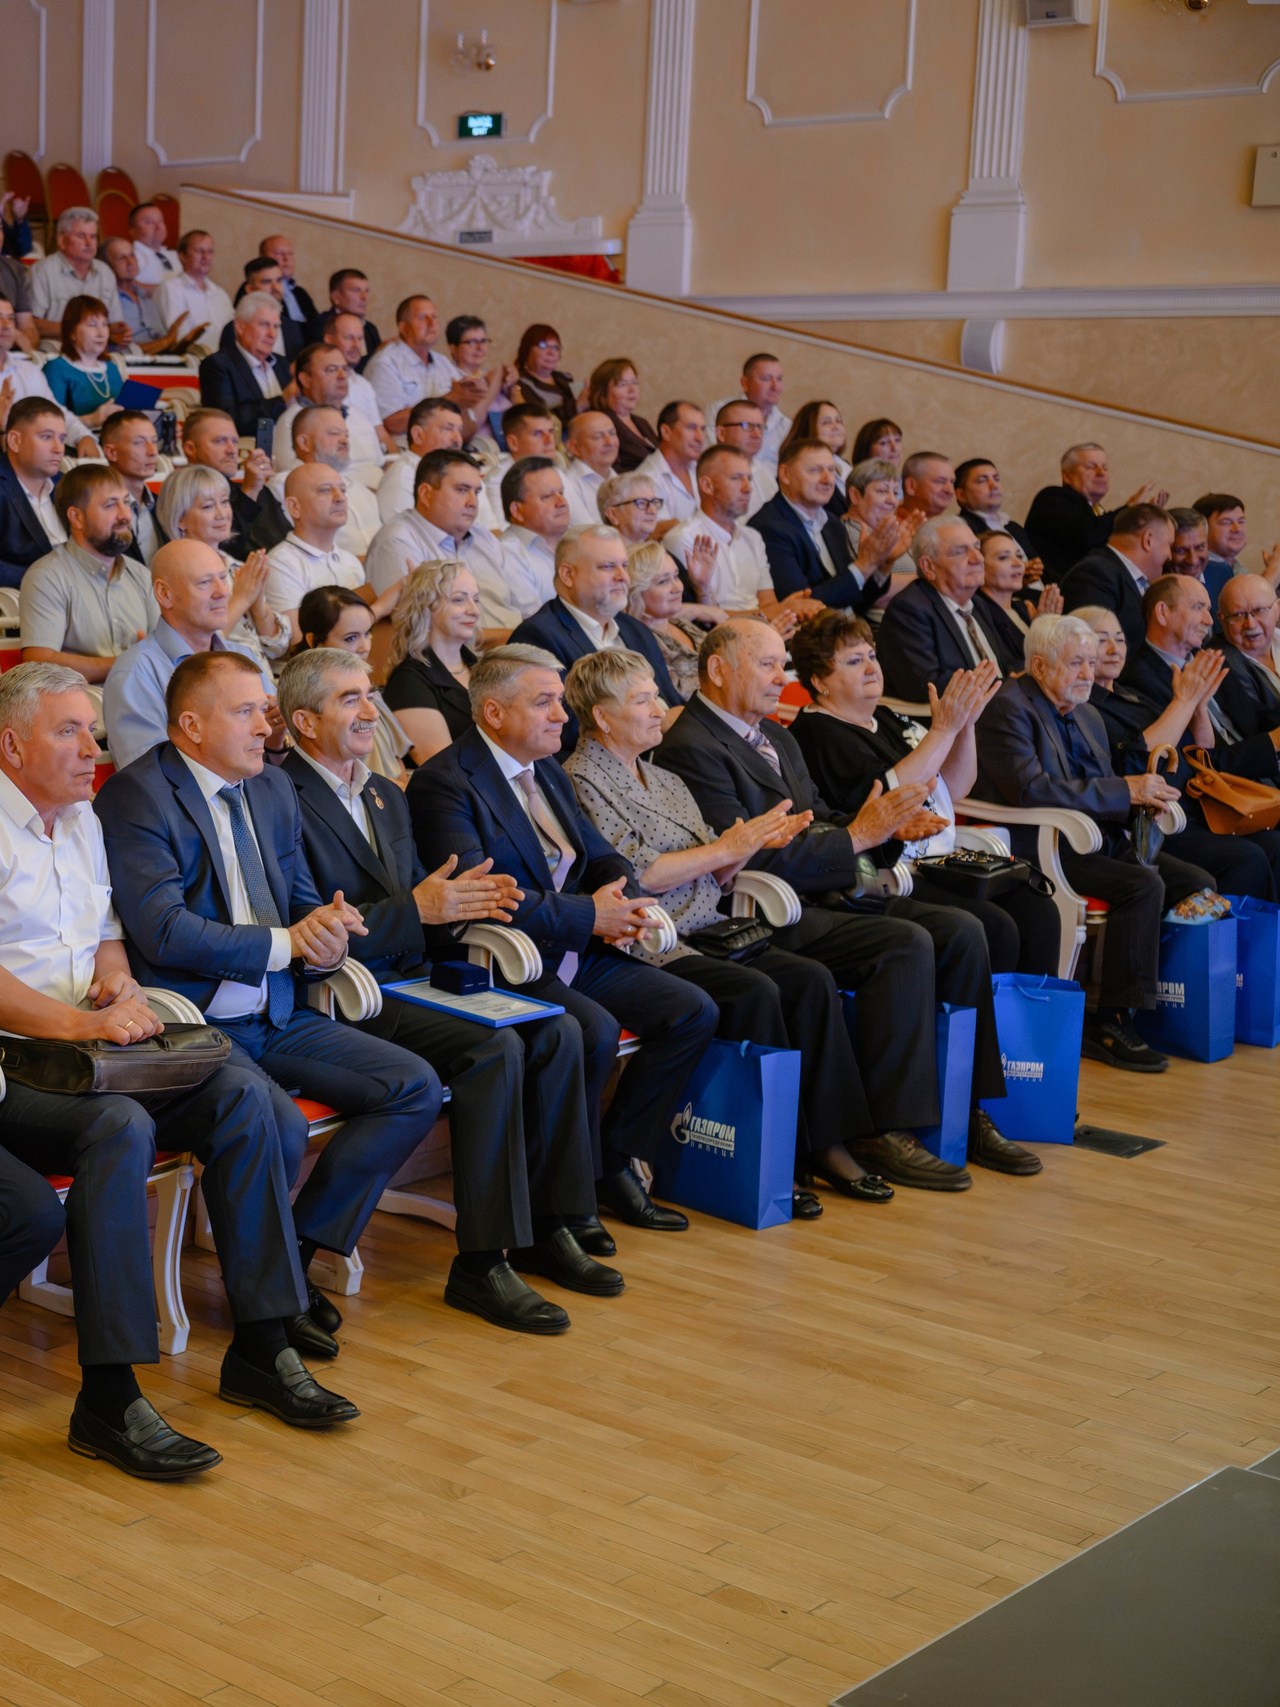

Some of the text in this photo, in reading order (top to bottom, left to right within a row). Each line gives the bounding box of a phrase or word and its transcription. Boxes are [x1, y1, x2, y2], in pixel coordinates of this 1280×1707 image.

[1157, 982, 1185, 995] ПРОМ
[1007, 1061, 1044, 1073] ГАЗПРОМ
[690, 1116, 736, 1142] ГАЗПРОМ
[690, 1141, 734, 1158] ЛИПЕЦК
